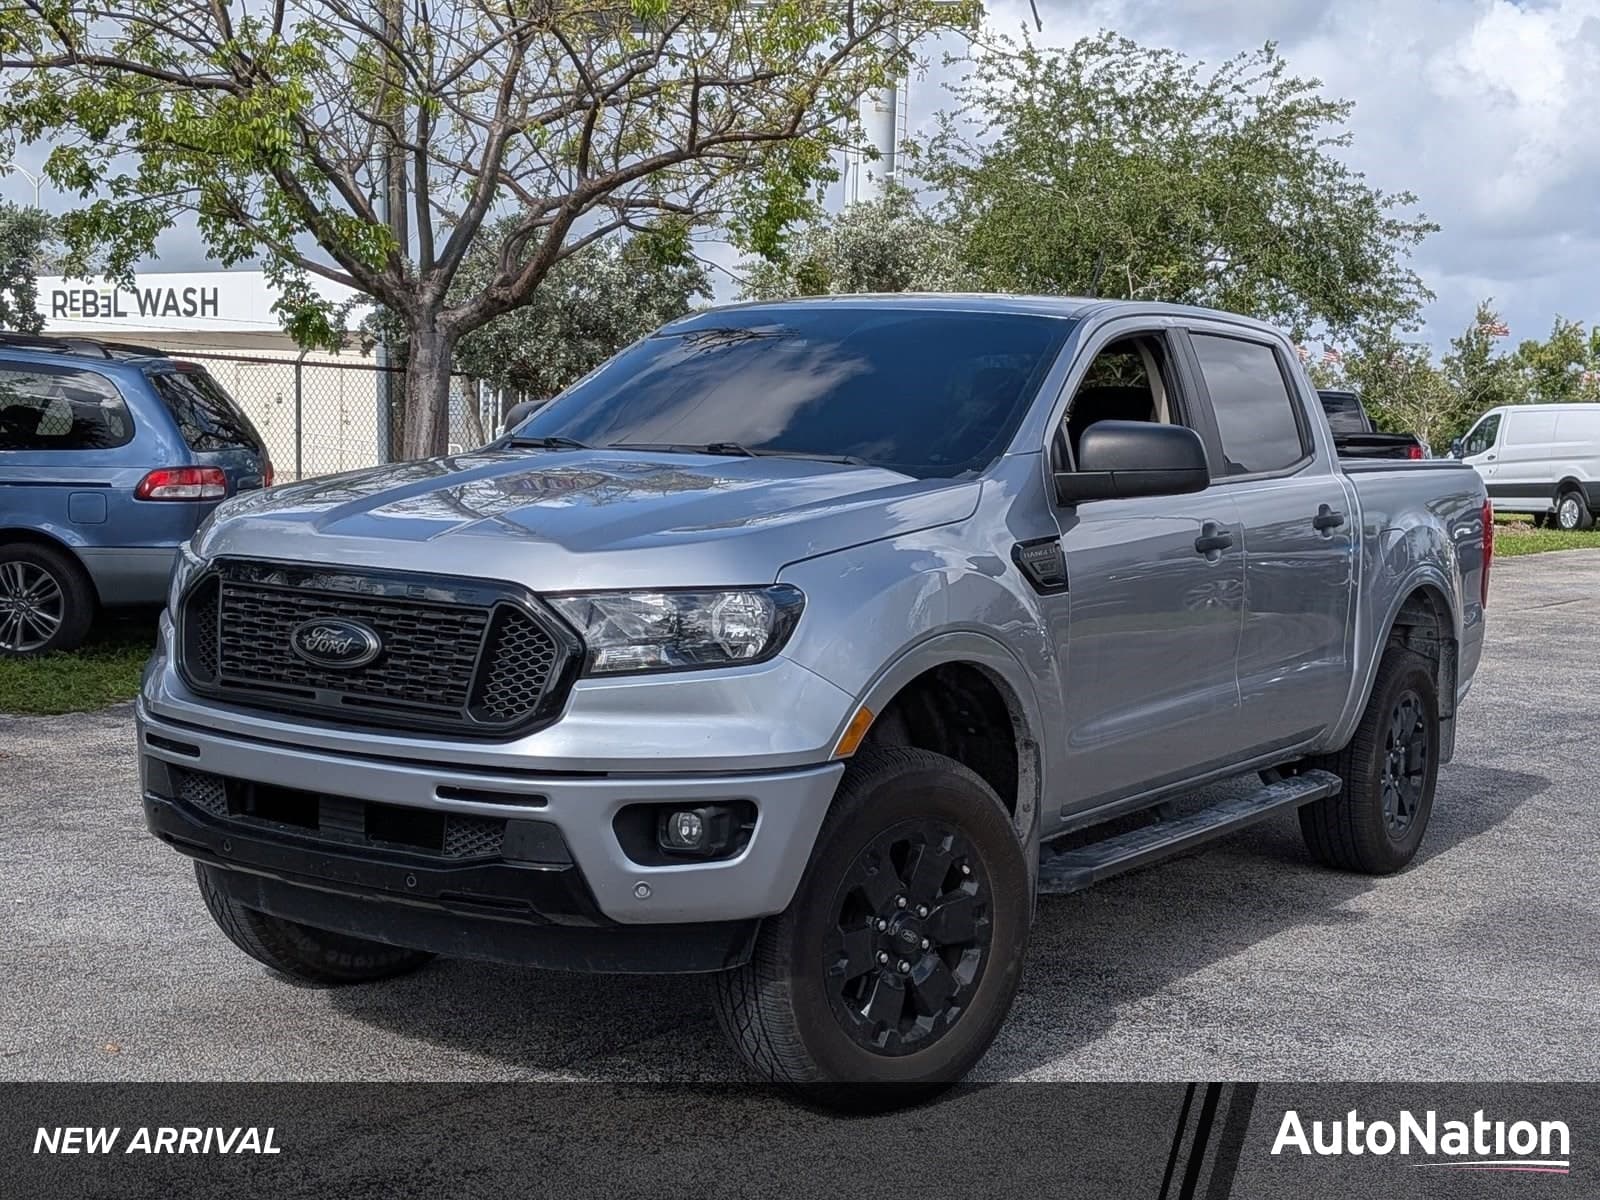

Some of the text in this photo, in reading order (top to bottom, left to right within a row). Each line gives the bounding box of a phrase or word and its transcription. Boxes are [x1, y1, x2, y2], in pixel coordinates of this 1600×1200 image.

[51, 287, 219, 318] REBEL WASH
[303, 626, 353, 655] Ford
